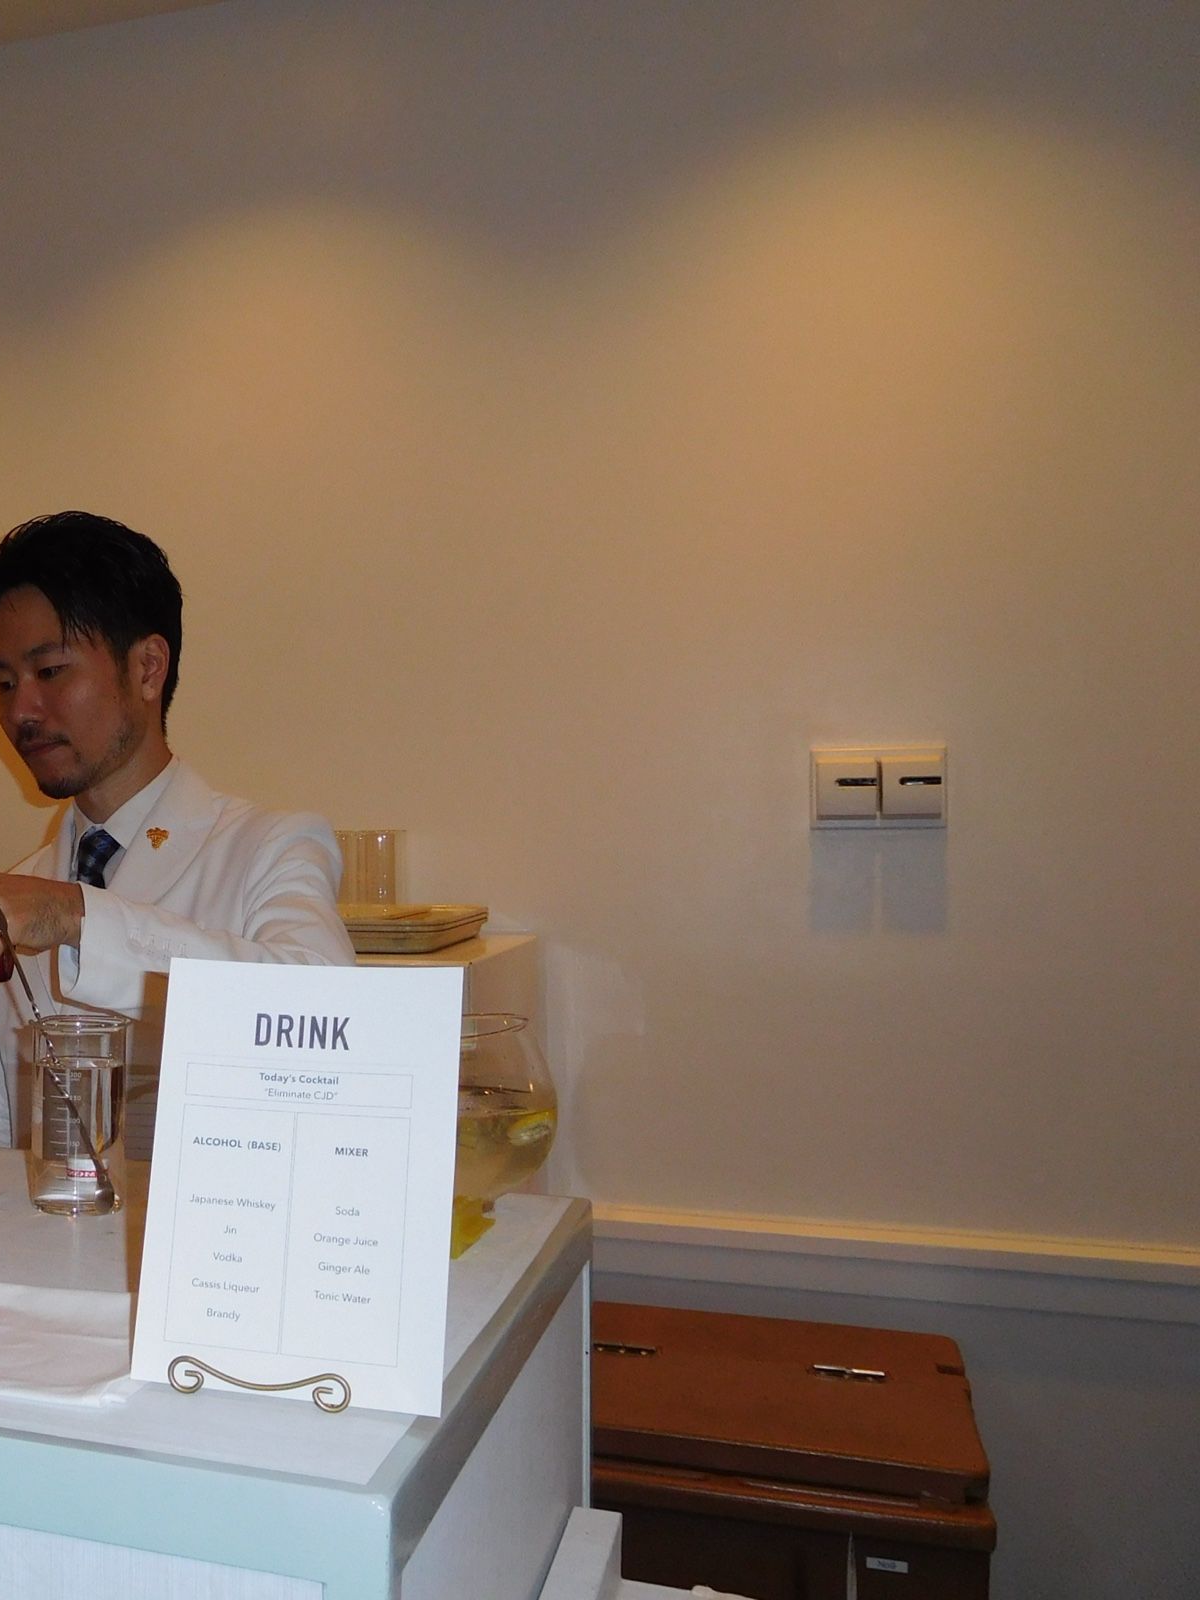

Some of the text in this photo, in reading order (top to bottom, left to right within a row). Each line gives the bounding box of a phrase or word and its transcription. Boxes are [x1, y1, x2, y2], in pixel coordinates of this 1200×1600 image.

[254, 1012, 351, 1051] DRINK
[259, 1072, 340, 1086] Today's Cocktail
[192, 1136, 282, 1152] ALCOHOL (BASE)
[334, 1147, 369, 1158] MIXER
[189, 1193, 276, 1212] Japanese Whiskey
[335, 1206, 360, 1217] Soda
[224, 1224, 237, 1235] Jin
[313, 1232, 379, 1247] Orange Juice
[213, 1252, 243, 1263] Vodka
[317, 1261, 371, 1275] Ginger Ale
[191, 1277, 260, 1295] Cassis Liqueur
[314, 1290, 371, 1305] Tonic Water
[206, 1307, 241, 1322] Brandy
